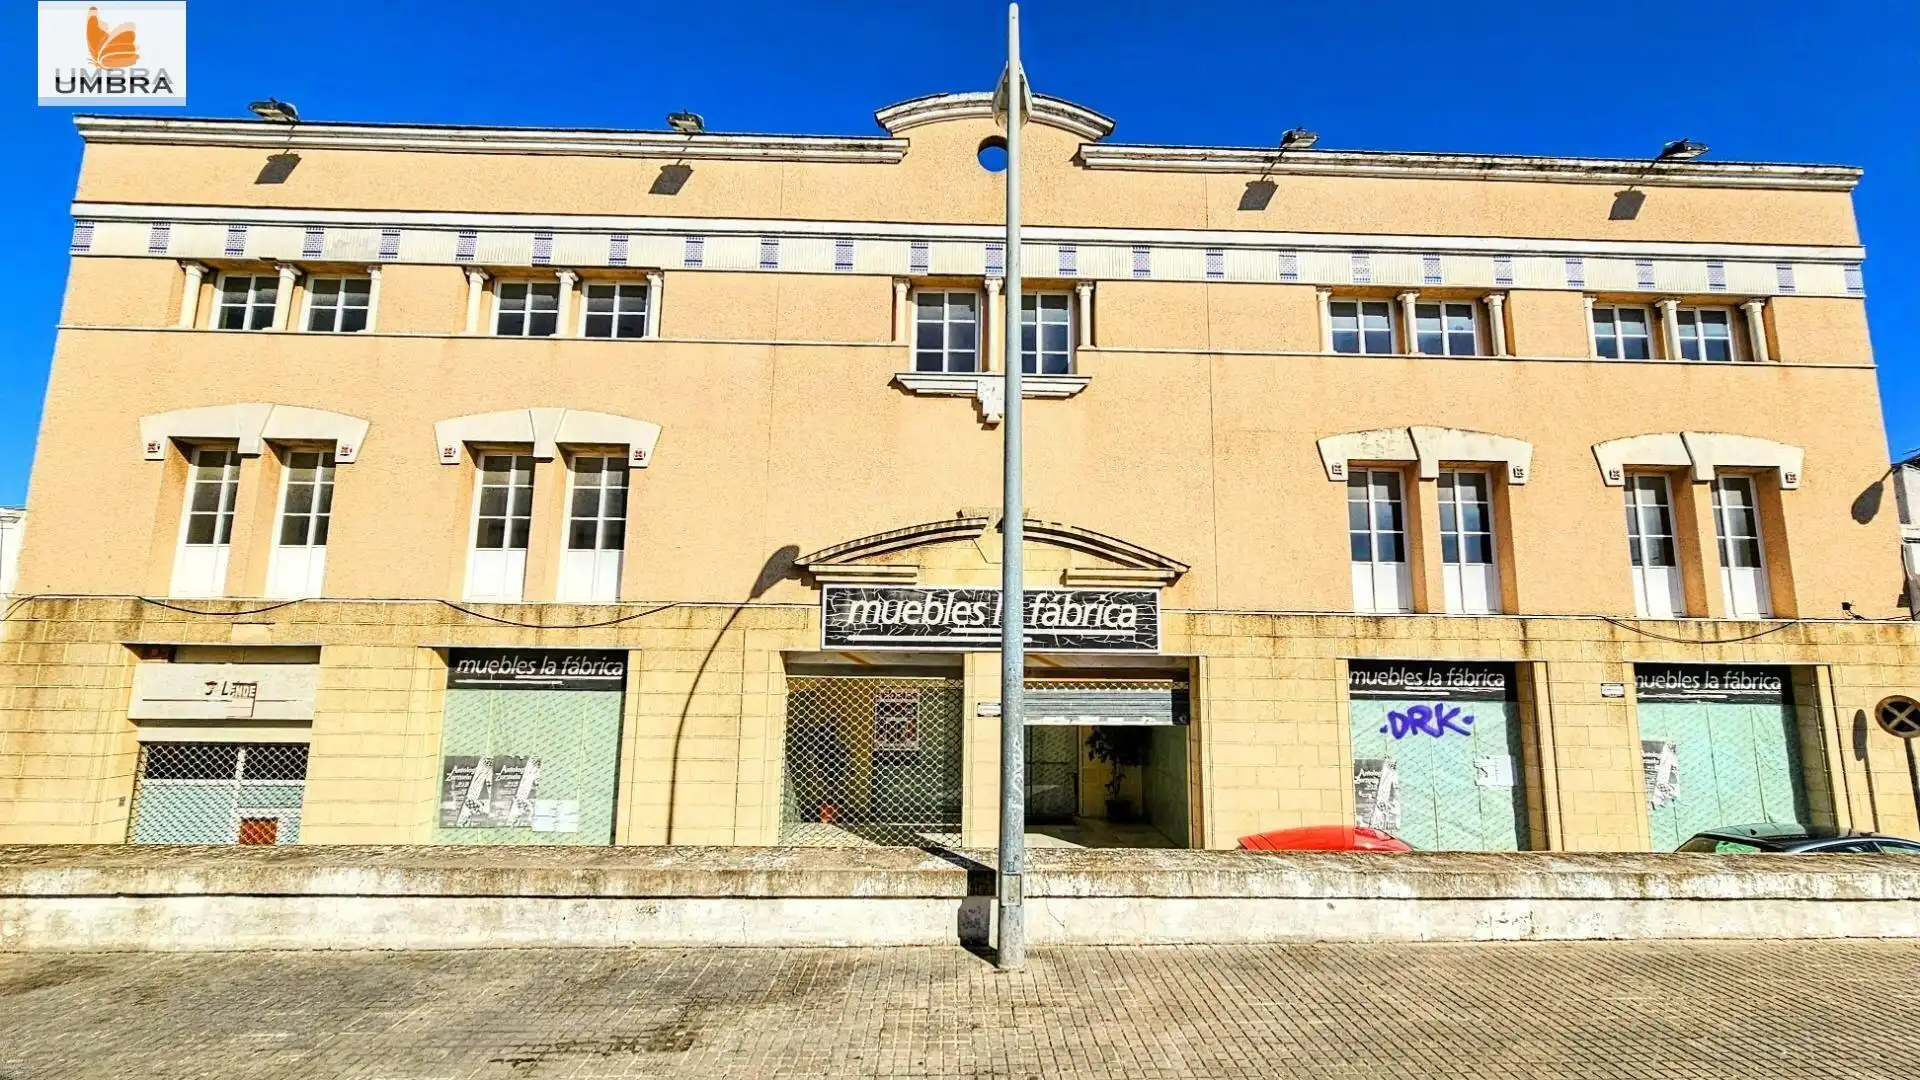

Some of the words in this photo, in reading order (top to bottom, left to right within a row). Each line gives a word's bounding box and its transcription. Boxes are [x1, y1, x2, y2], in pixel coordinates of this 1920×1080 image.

[847, 593, 987, 626] muebles
[1029, 592, 1138, 629] fábrica
[456, 655, 537, 676] muebles
[540, 656, 557, 676] la
[561, 656, 624, 677] fábrica
[1349, 666, 1423, 687] muebles
[1427, 667, 1442, 686] la
[1447, 667, 1505, 687] fábrica
[1704, 670, 1719, 689] la
[1723, 670, 1781, 690] fábrica
